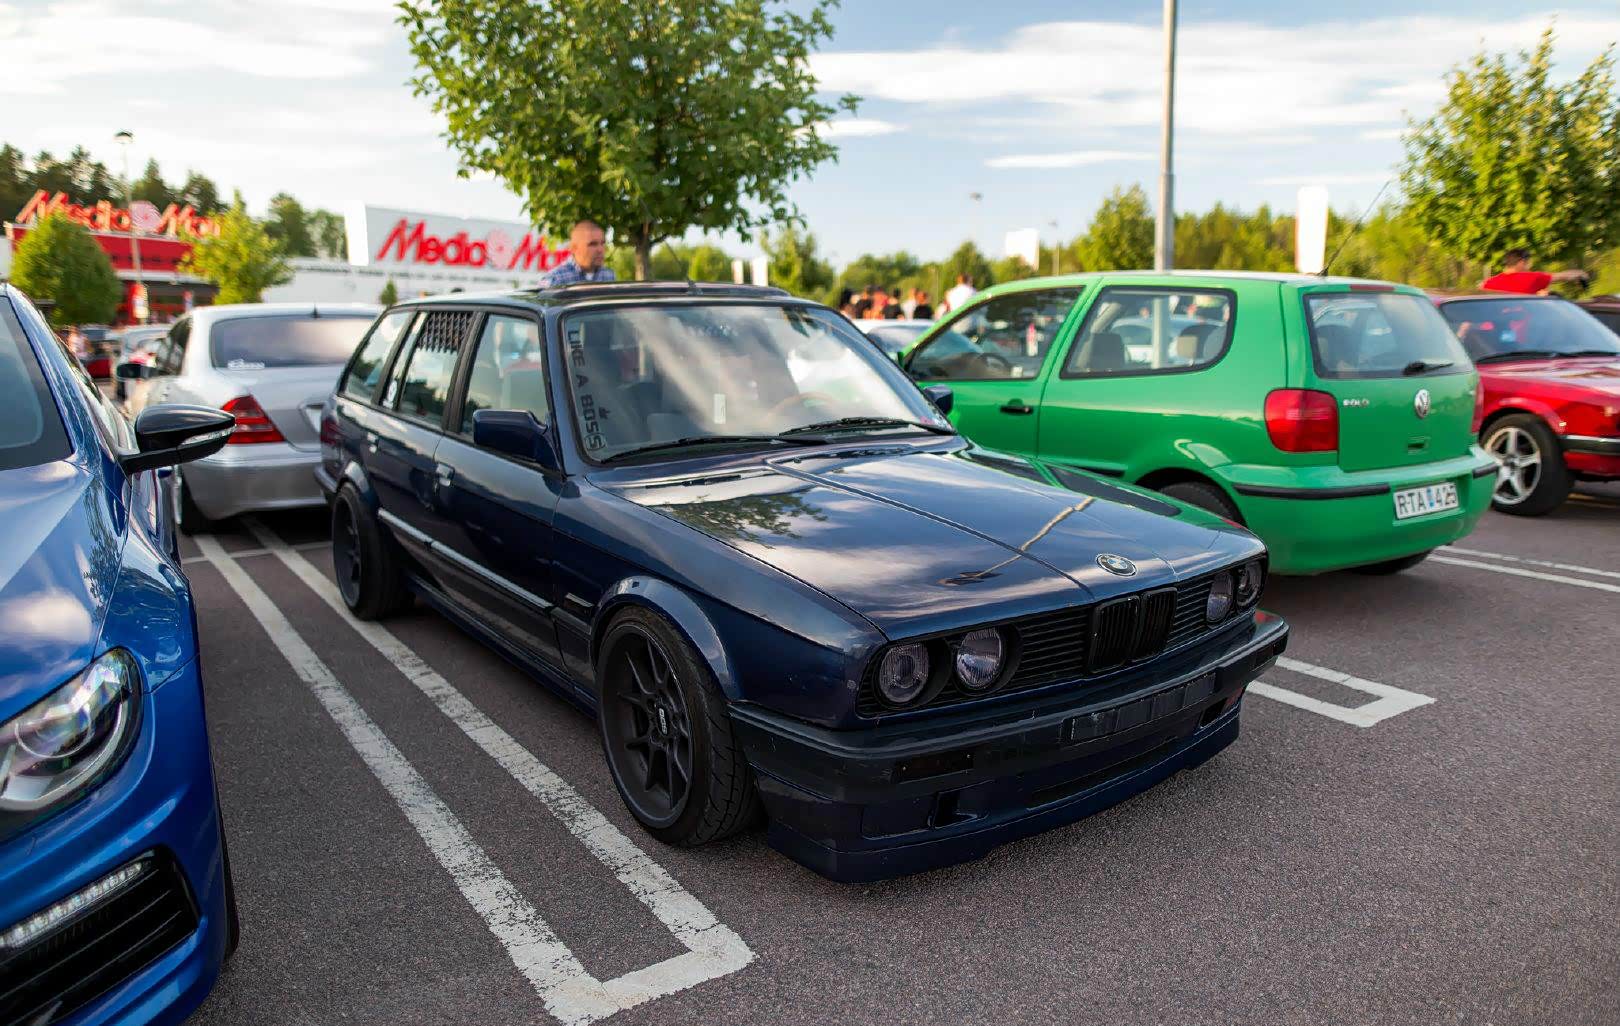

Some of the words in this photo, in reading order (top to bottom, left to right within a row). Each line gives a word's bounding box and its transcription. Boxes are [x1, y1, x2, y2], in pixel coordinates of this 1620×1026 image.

[376, 217, 487, 267] Media
[576, 374, 590, 388] A
[1397, 492, 1427, 515] RTA
